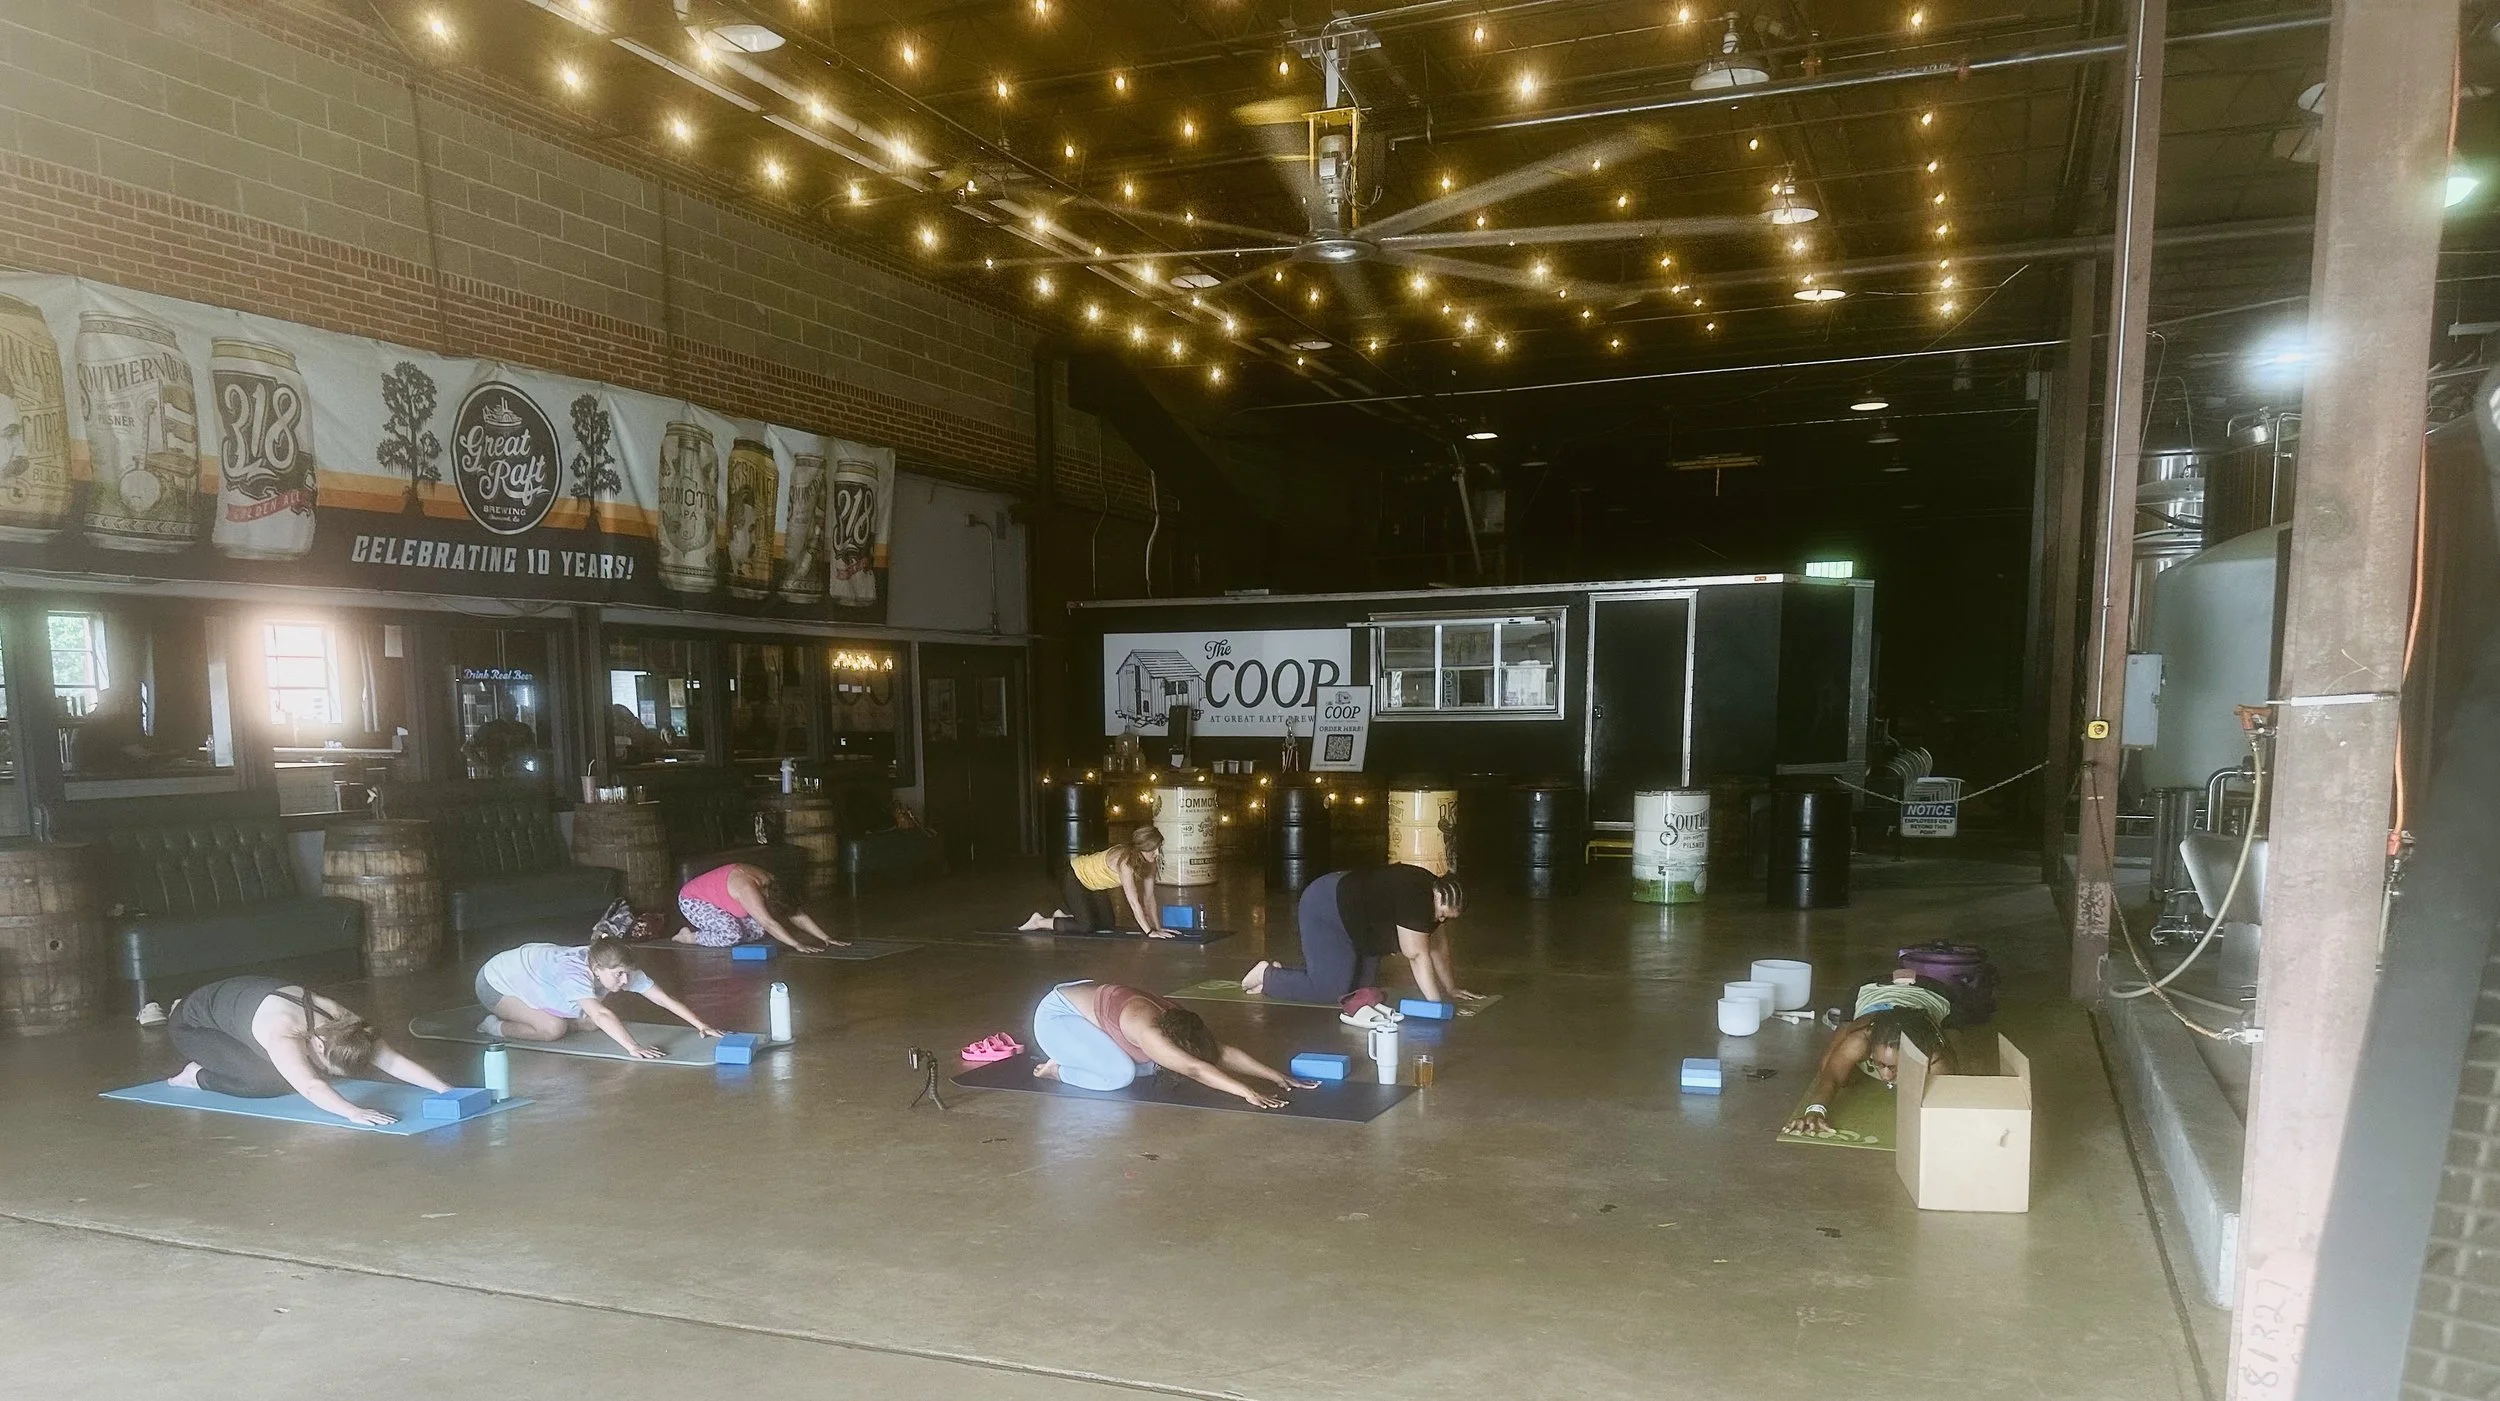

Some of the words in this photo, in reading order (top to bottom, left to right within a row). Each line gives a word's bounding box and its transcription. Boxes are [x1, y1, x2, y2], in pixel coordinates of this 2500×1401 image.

[77, 357, 165, 421] SOUTHERN
[222, 381, 299, 480] 318
[460, 425, 531, 472] Great
[480, 454, 551, 505] Raft
[483, 504, 527, 517] BREWING
[833, 487, 875, 552] 318
[351, 535, 516, 573] CELEBRATING
[527, 550, 550, 575] 10
[561, 551, 635, 580] YEARS!
[1204, 639, 1232, 660] The
[464, 668, 490, 680] Drink
[491, 669, 512, 680] Real
[1205, 658, 1340, 708] COOP
[1210, 715, 1222, 723] AT
[1224, 715, 1256, 723] GREAT
[1259, 715, 1285, 723] RAFT
[1325, 705, 1361, 719] COOP
[1907, 804, 1952, 816] NOTICE
